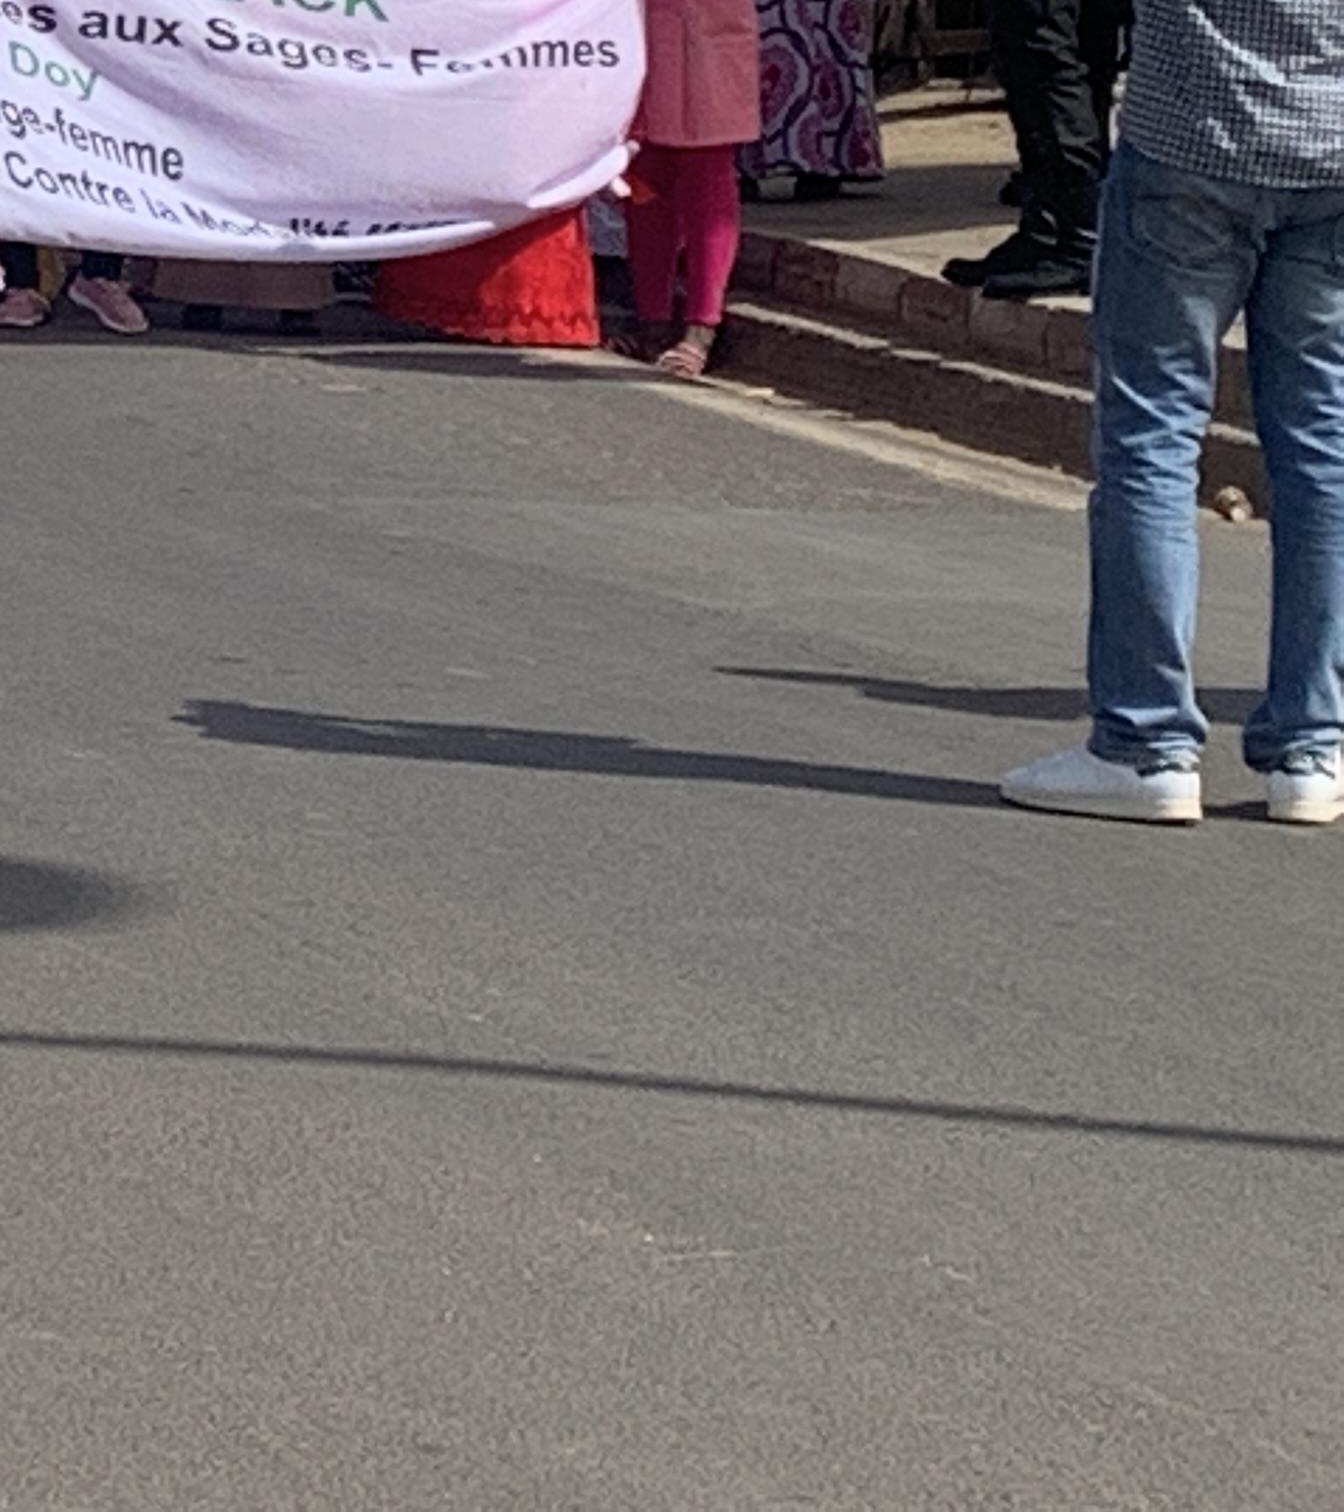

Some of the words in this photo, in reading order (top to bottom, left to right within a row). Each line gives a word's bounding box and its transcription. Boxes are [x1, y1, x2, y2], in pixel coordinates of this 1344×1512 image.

[77, 8, 184, 50] aux
[8, 40, 103, 102] Doy
[3, 150, 134, 217] Contre
[139, 186, 182, 225] la
